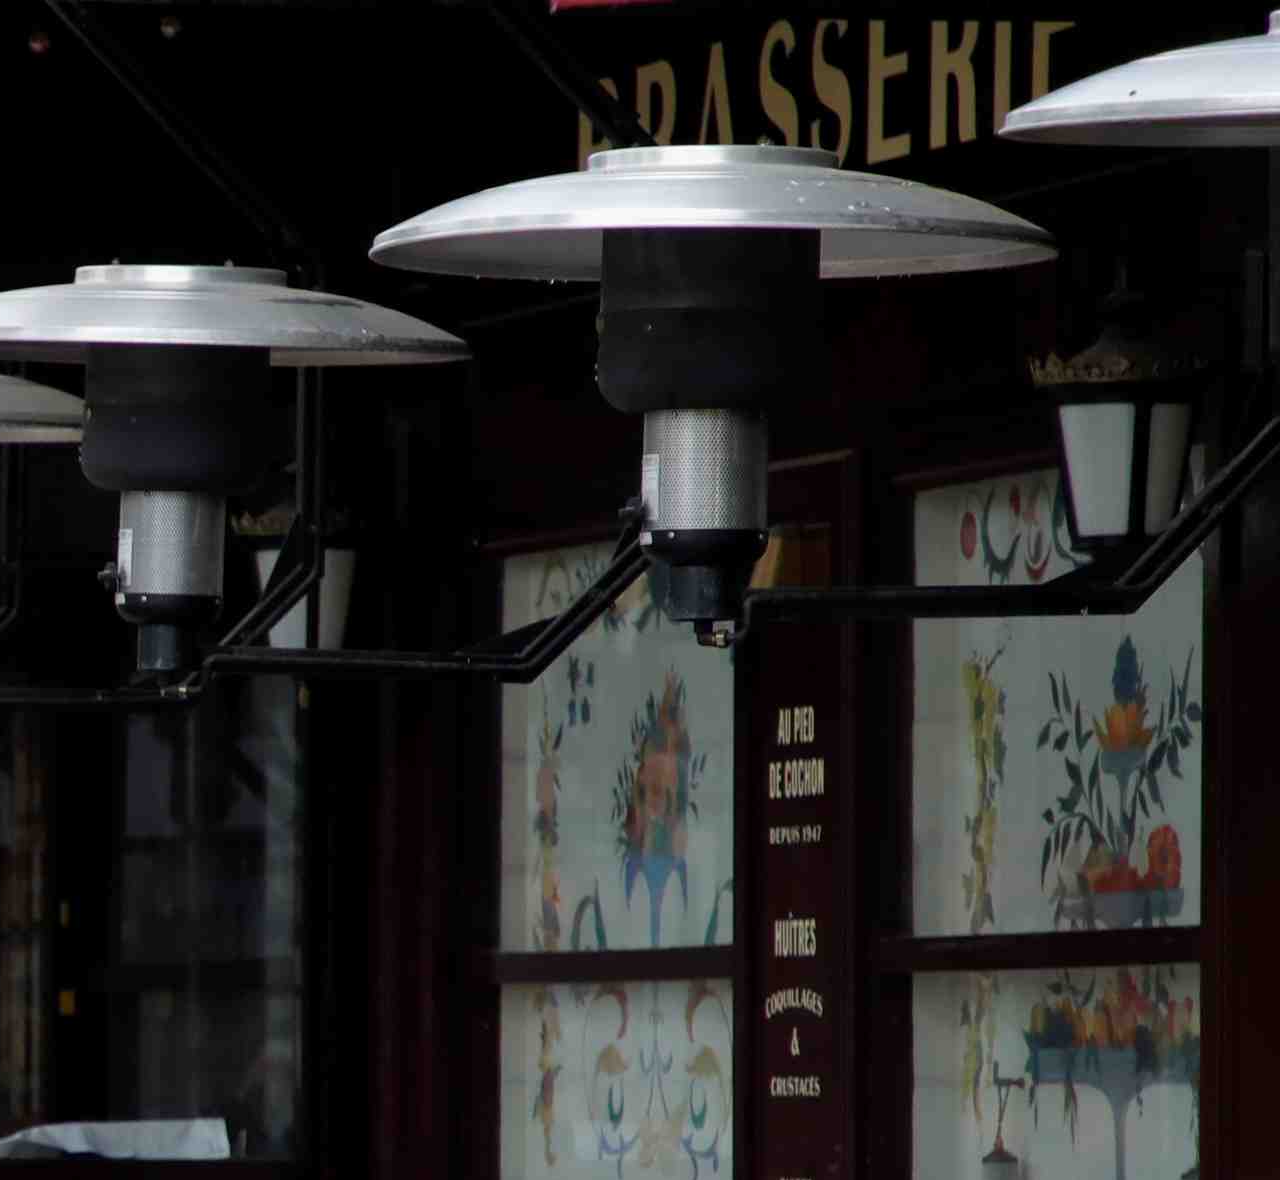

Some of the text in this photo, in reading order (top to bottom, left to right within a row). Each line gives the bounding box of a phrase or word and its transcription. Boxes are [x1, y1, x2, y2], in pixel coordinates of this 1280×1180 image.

[778, 706, 814, 744] AU PIED
[769, 758, 824, 799] DE COCHON
[769, 824, 822, 845] DEPUIS 1947
[774, 911, 817, 957] HUÎTRES
[765, 986, 823, 1019] COQUILLAGES
[790, 1026, 800, 1056] &
